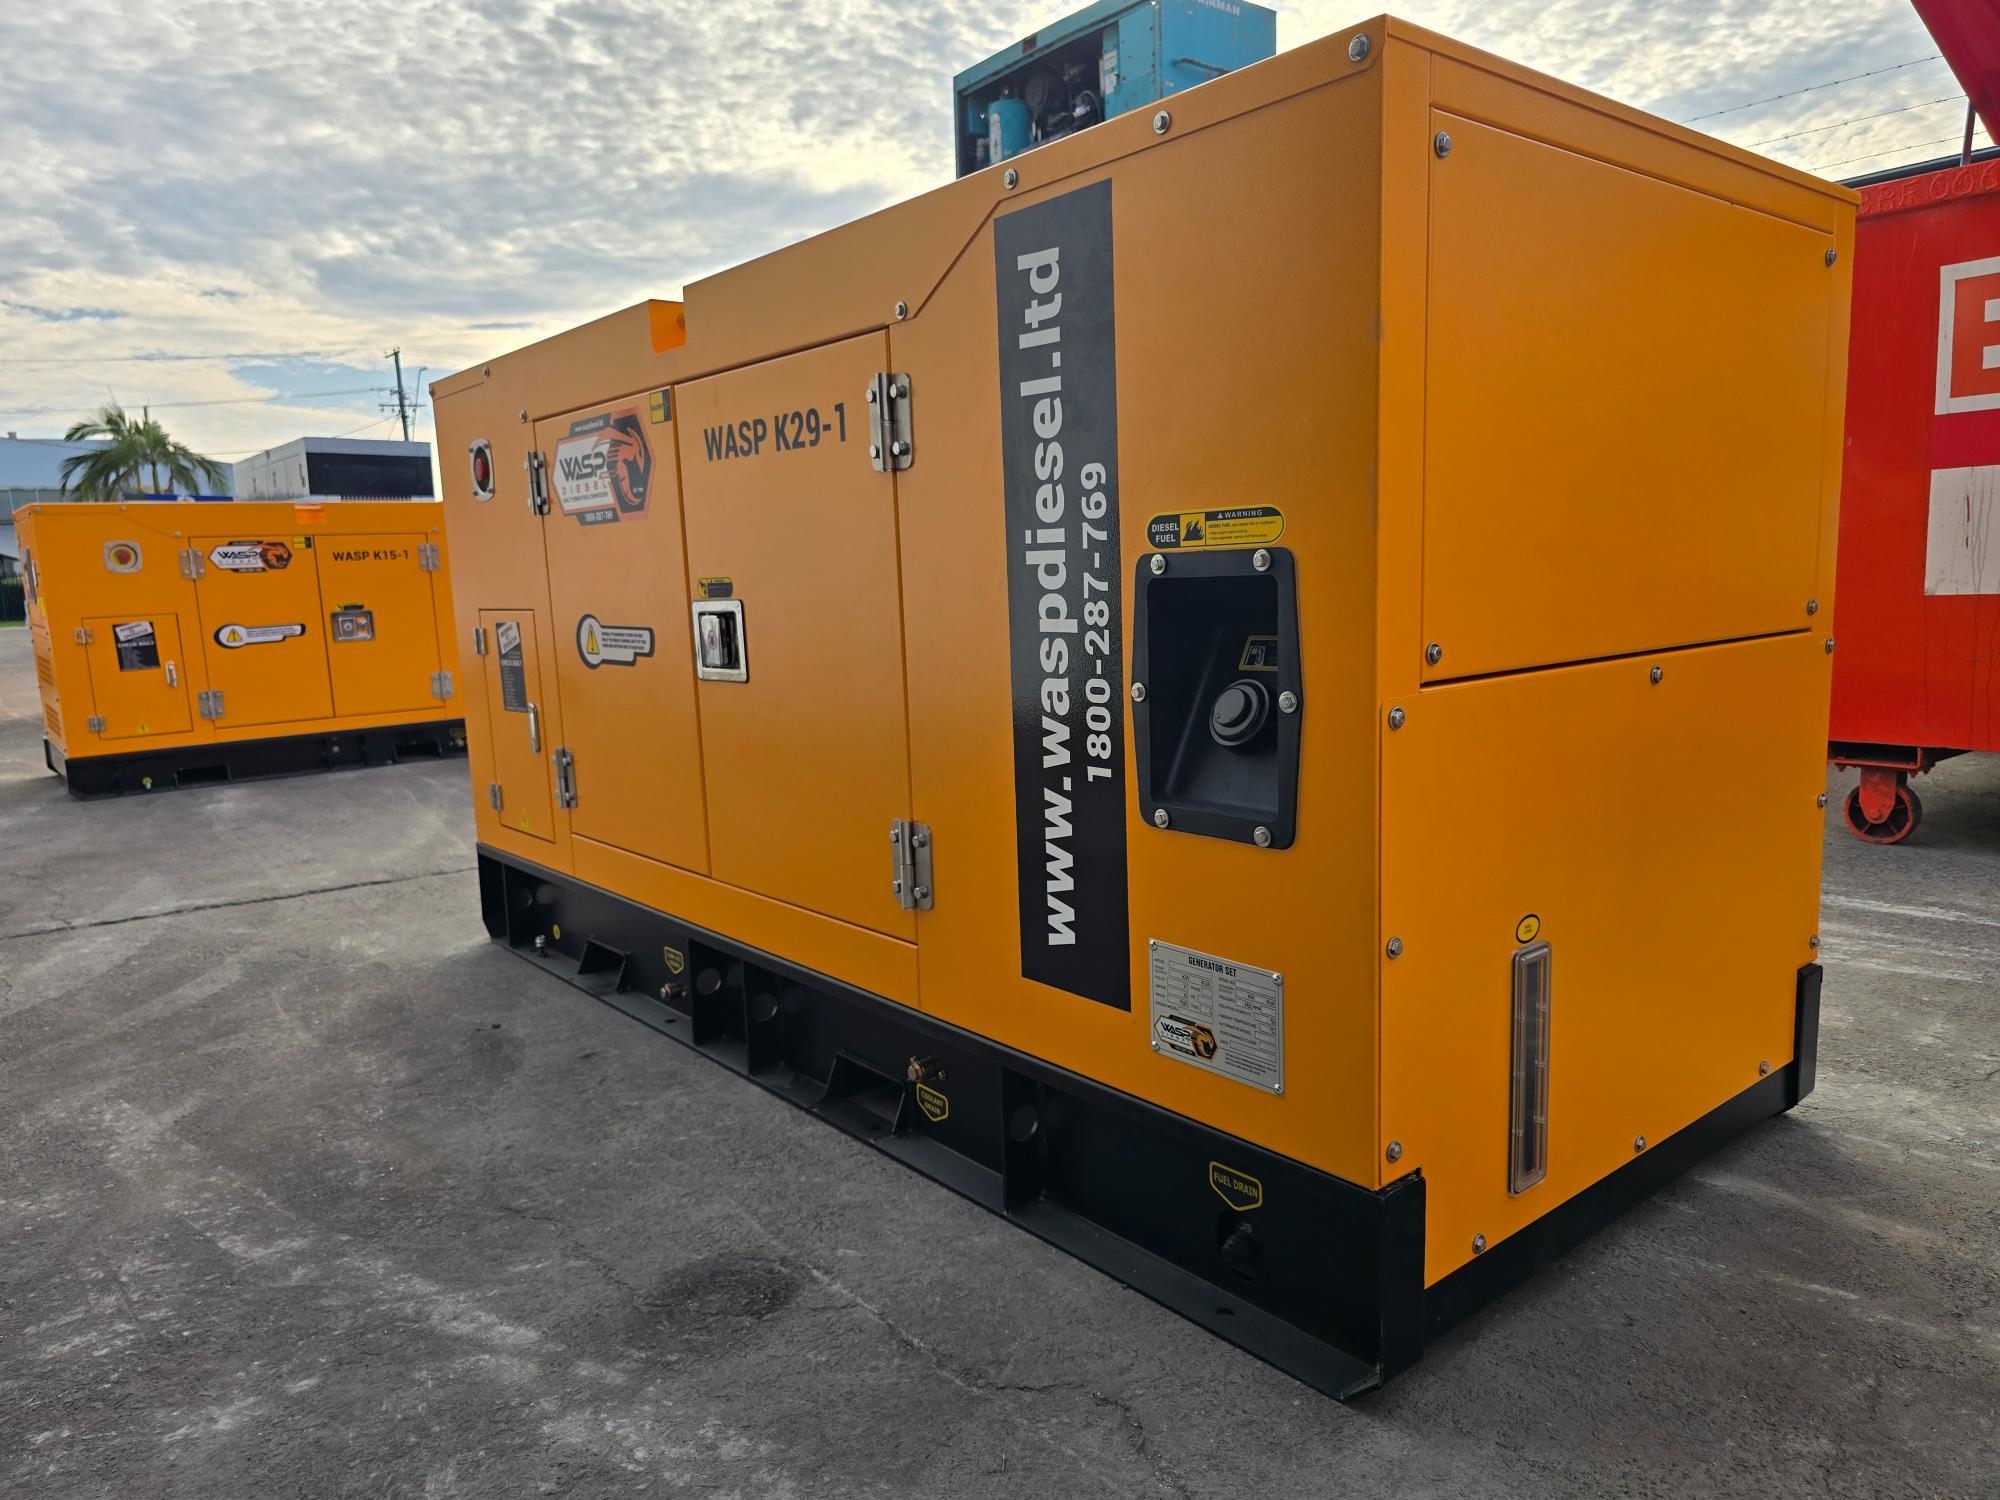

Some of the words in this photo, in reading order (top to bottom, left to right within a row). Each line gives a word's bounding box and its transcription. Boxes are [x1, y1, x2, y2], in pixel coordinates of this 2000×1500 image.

[703, 418, 767, 462] WASP
[774, 402, 846, 452] K29-1
[559, 451, 606, 482] WASP
[1224, 509, 1263, 519] WARNING
[1151, 522, 1180, 533] DIESEL
[1155, 534, 1176, 544] FUEL
[217, 551, 258, 560] WASP
[332, 551, 370, 562] WASP
[373, 550, 409, 561] K15-1
[1017, 247, 1078, 945] www.waspdiesel.ltd
[1080, 462, 1112, 782] 1800-287-769
[1188, 956, 1224, 974] GENERATOR
[1225, 966, 1237, 977] SET
[1160, 1021, 1191, 1038] WASP
[1213, 1171, 1232, 1188] FUEL
[1233, 1180, 1258, 1199] DRAIN
